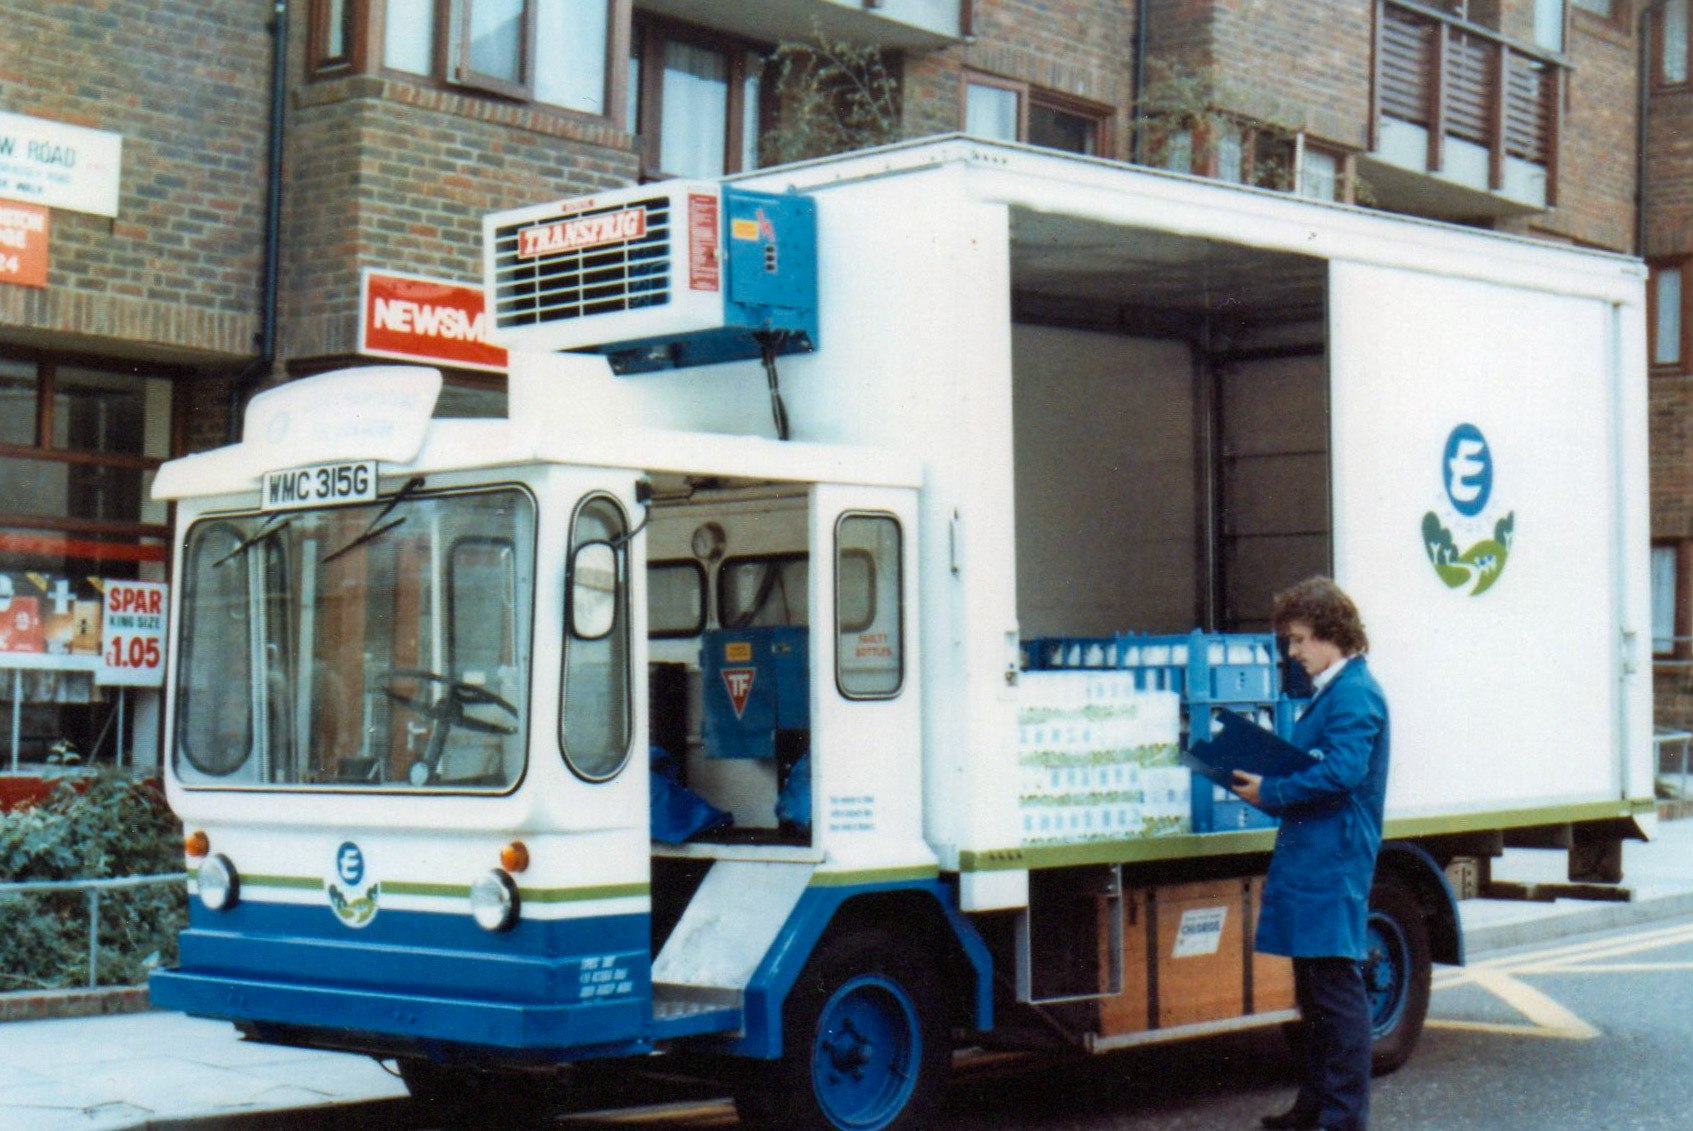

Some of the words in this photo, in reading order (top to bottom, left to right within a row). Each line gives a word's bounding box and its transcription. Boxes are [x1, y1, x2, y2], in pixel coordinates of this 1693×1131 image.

[27, 139, 77, 168] ROAD
[524, 210, 641, 255] TRANSFRIG
[269, 471, 310, 503] WMC
[315, 464, 369, 499] 315G
[108, 586, 163, 614] SPAR
[108, 614, 135, 628] KING
[137, 615, 161, 629] SIZE
